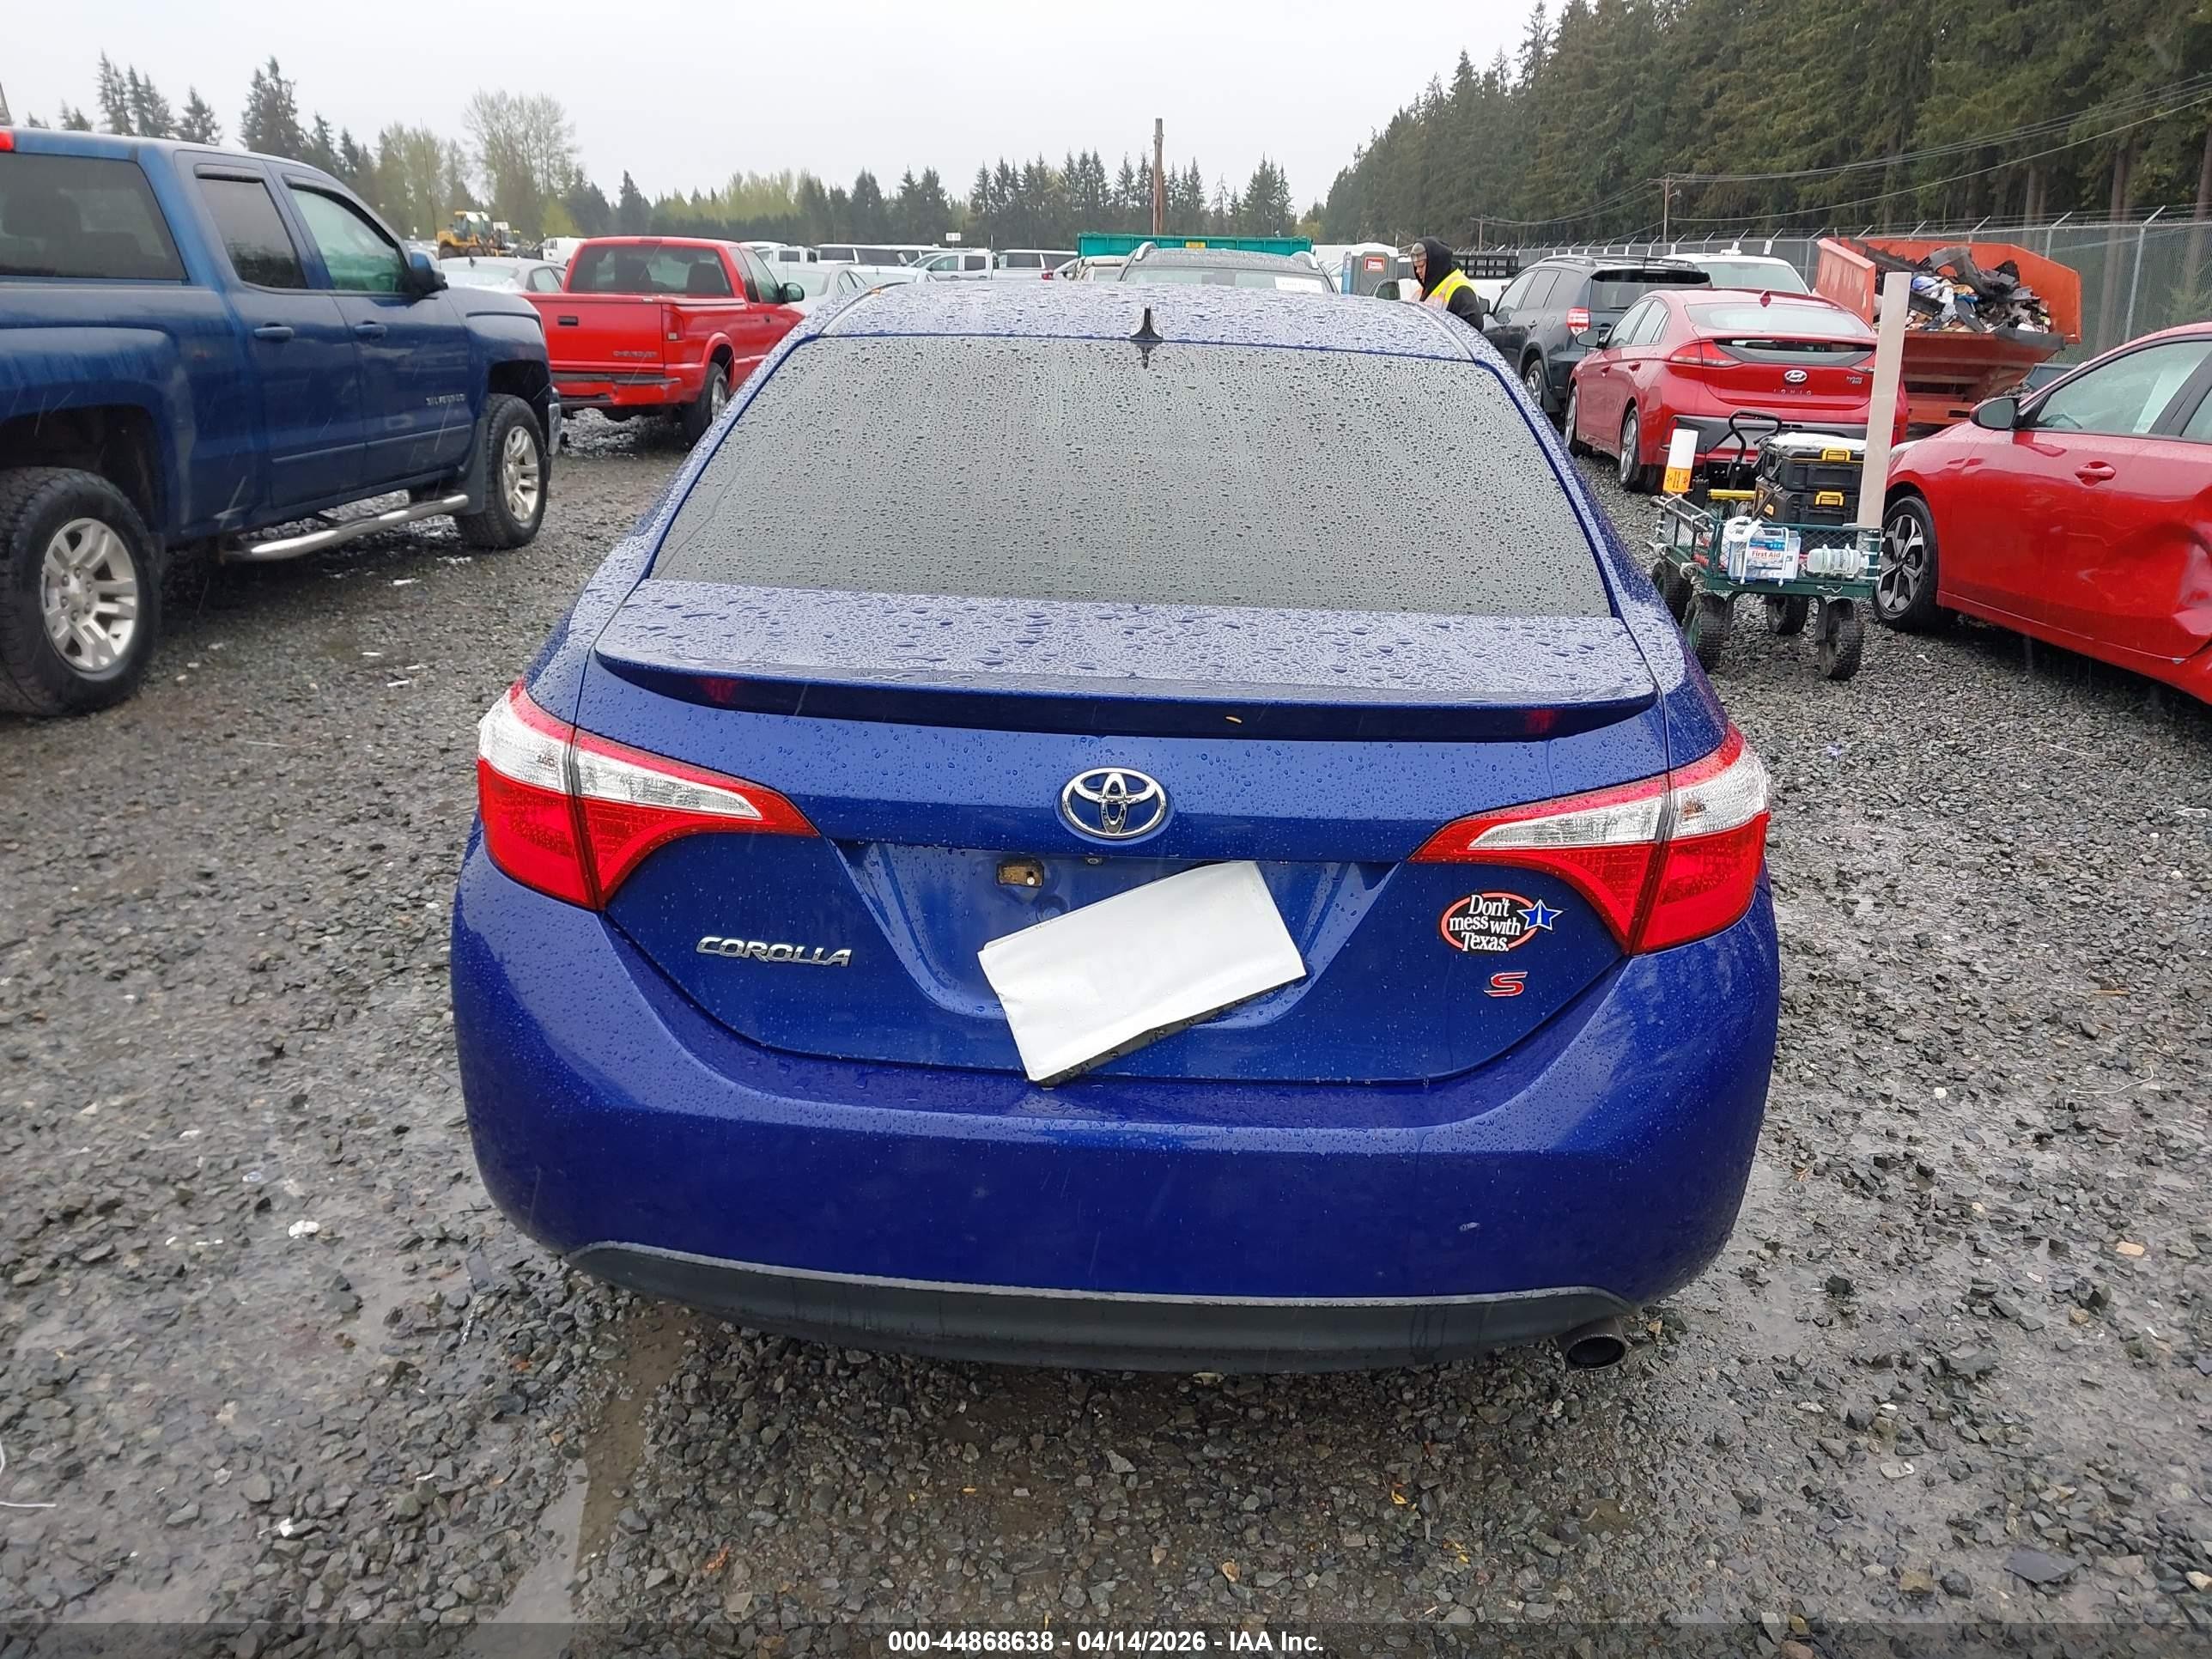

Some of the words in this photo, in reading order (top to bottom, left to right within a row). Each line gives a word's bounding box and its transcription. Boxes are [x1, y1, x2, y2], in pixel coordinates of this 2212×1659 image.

[1468, 895, 1510, 917] Don't
[1449, 915, 1488, 932] mess
[1490, 917, 1521, 936] with
[696, 936, 852, 967] COROLLA
[1461, 932, 1510, 952] Texas.
[1484, 971, 1528, 997] S
